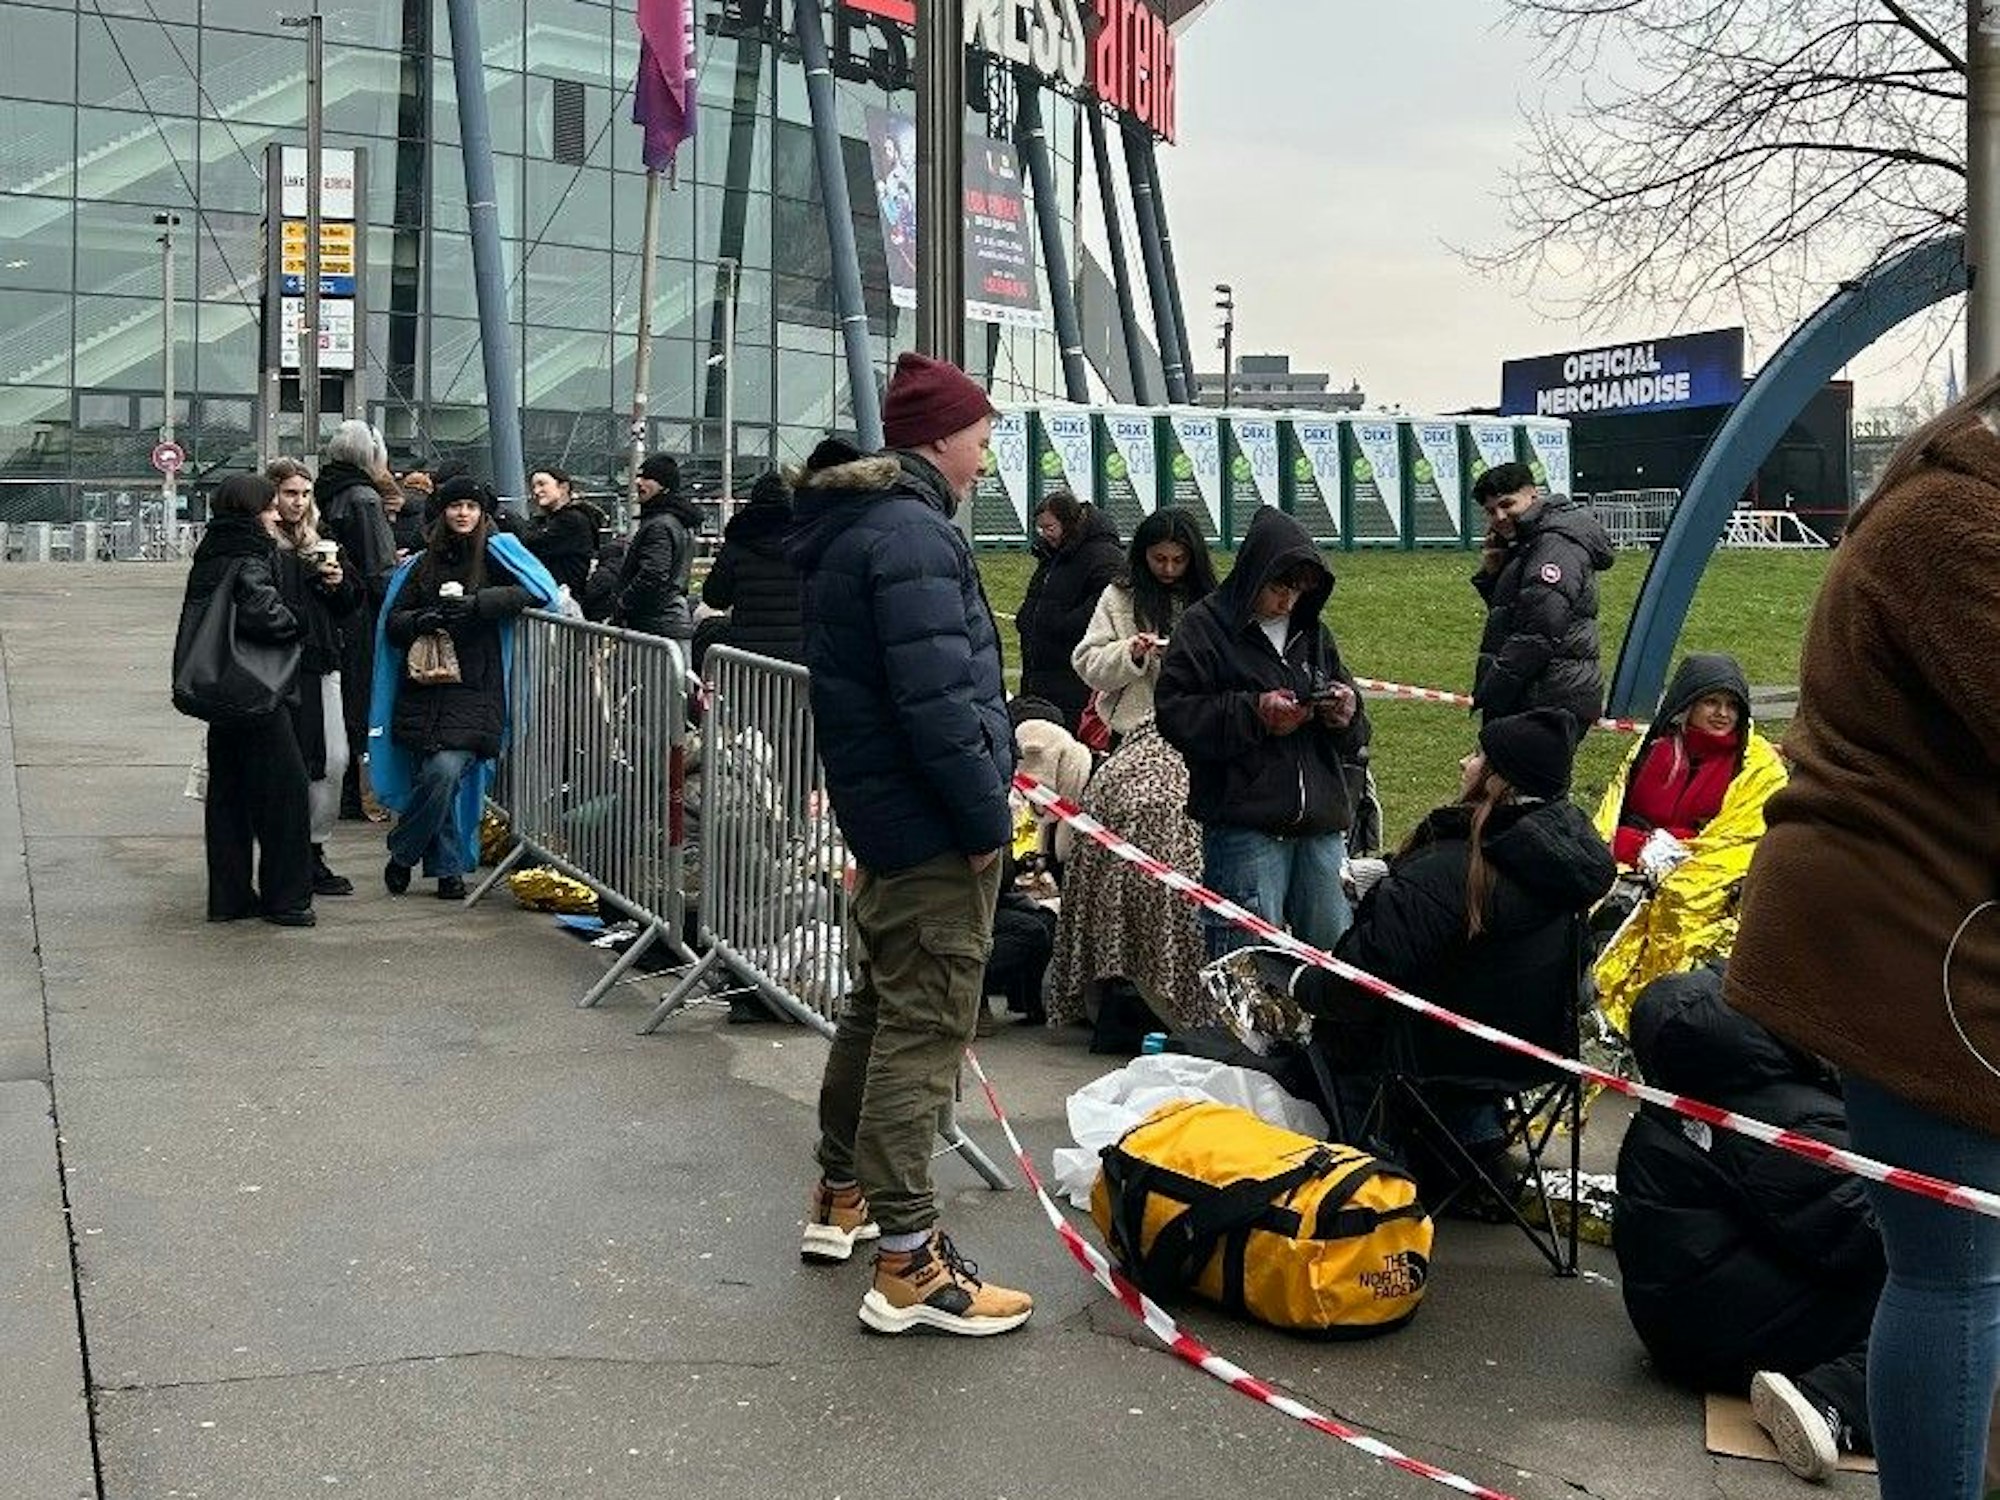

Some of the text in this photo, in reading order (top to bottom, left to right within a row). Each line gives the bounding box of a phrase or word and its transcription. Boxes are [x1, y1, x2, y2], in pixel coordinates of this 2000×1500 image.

[1563, 344, 1662, 382] OFFICIAL
[1536, 372, 1691, 416] MERCHANDISE
[1383, 1253, 1409, 1272] THE
[1359, 1267, 1410, 1288] NORTH
[1373, 1283, 1411, 1301] FACE
